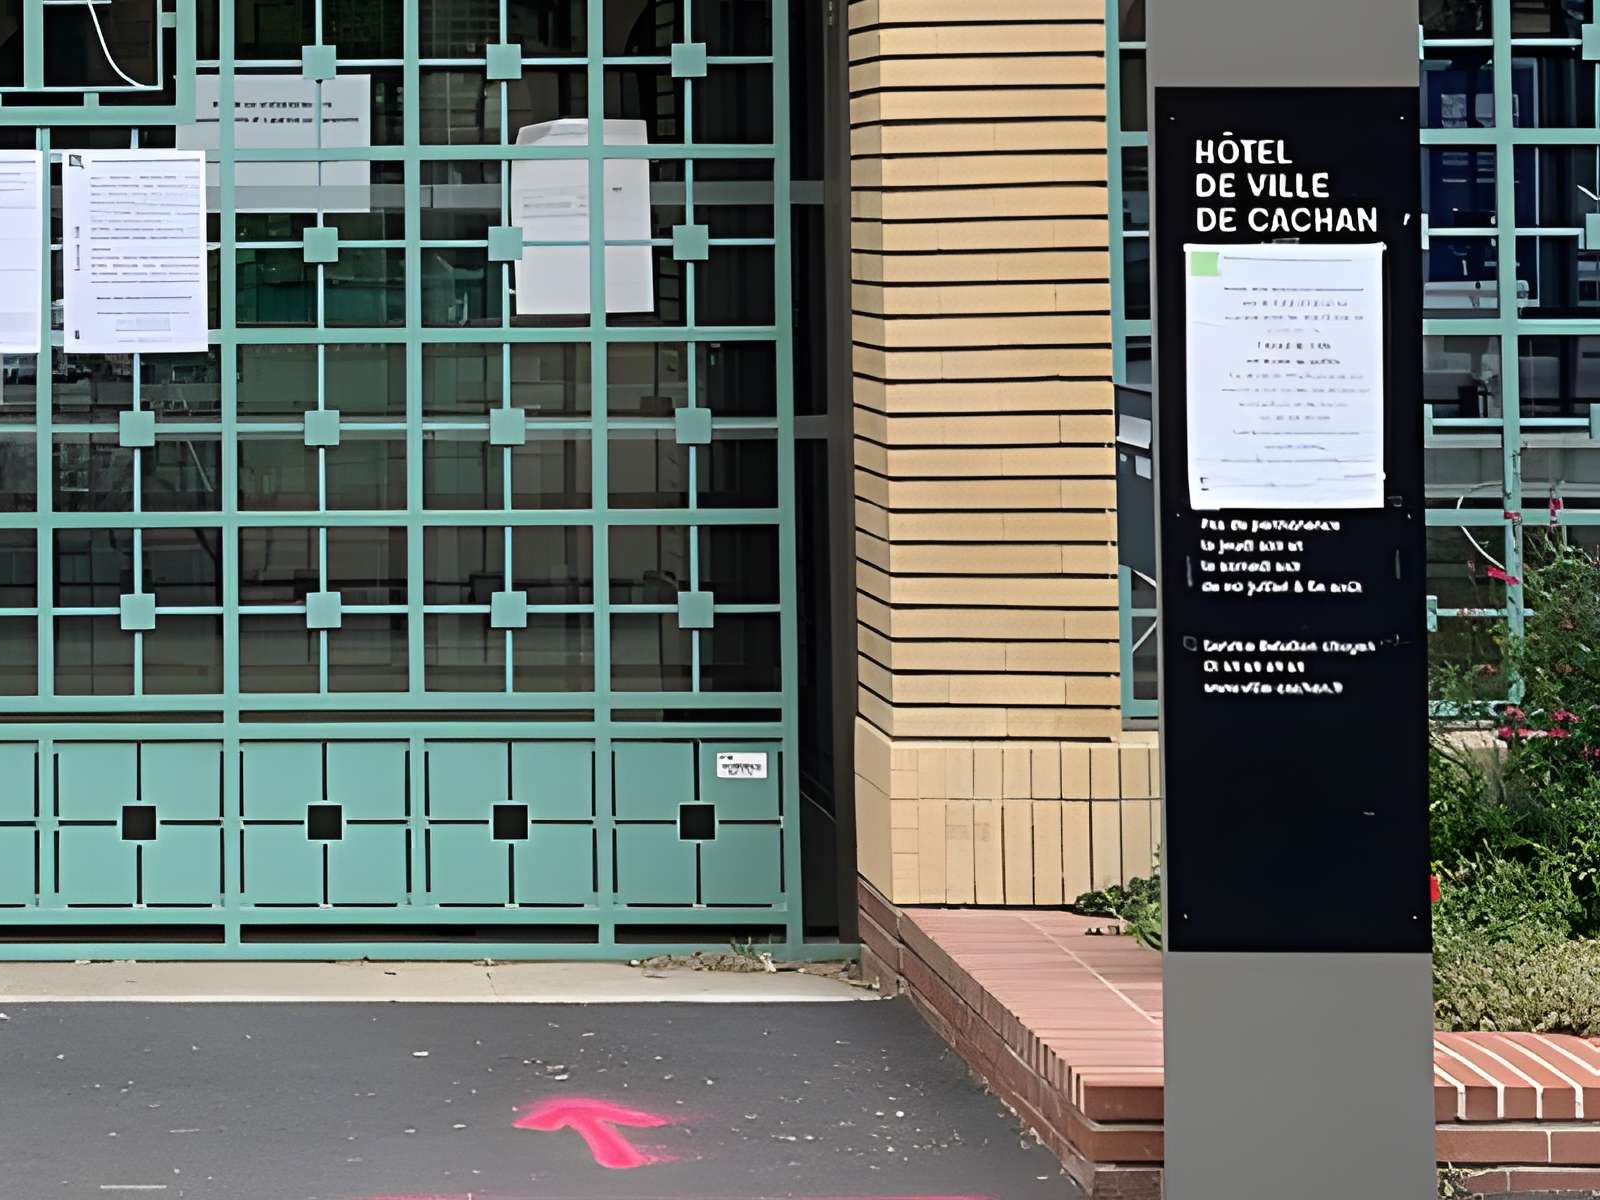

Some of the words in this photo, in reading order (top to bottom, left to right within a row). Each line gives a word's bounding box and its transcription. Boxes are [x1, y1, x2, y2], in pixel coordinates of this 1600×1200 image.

[1195, 131, 1293, 164] HÔTEL
[1195, 172, 1236, 198] DE
[1247, 171, 1330, 199] VILLE
[1196, 206, 1237, 233] DE
[1248, 206, 1377, 233] CACHAN
